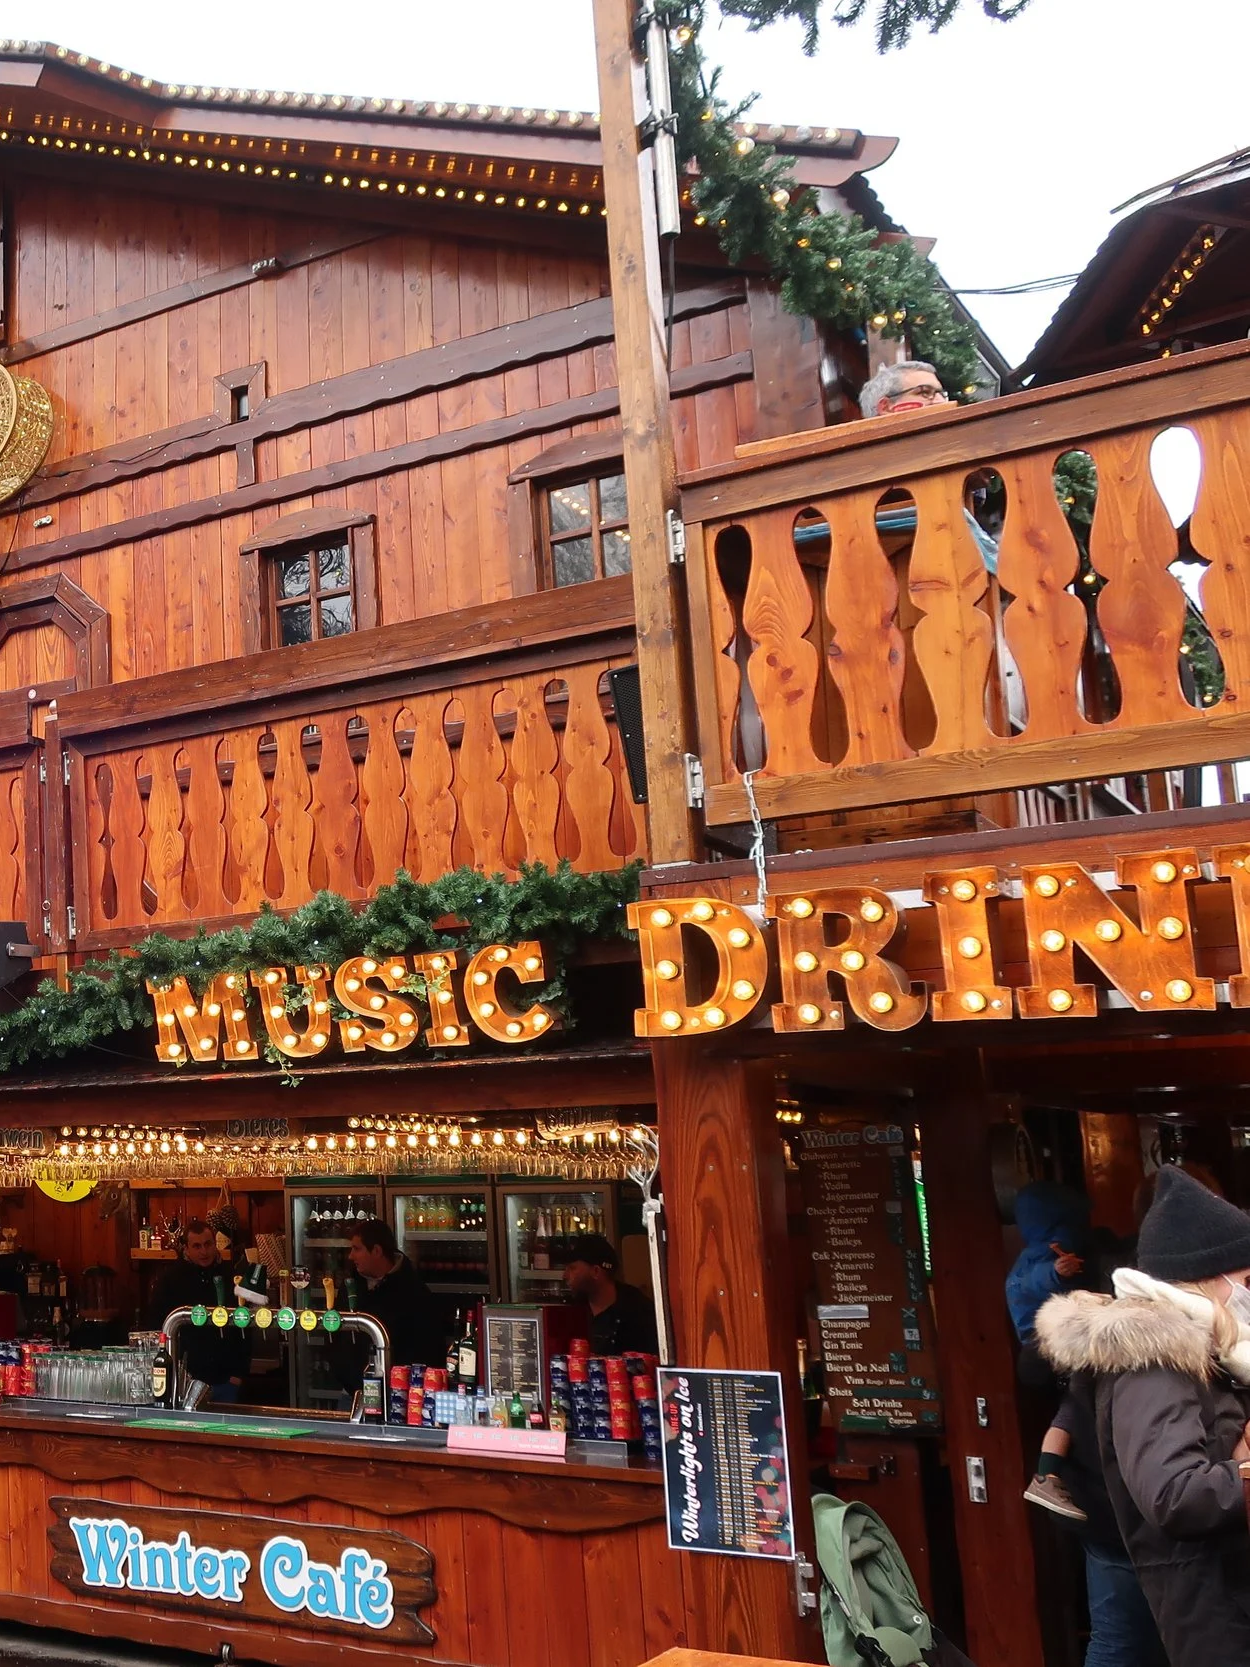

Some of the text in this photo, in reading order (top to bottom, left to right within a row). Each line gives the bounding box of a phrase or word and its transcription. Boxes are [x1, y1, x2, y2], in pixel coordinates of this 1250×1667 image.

[146, 941, 554, 1063] MUSIC
[800, 1125, 904, 1148] Winter Café
[830, 1227, 855, 1236] Rhum
[832, 1251, 875, 1261] Nespresso
[834, 1262, 874, 1271] Amaretto
[835, 1272, 861, 1281] Rhum
[836, 1283, 868, 1292] Baileys
[821, 1320, 870, 1330] Champagne
[823, 1340, 863, 1350] Gin Tonic
[855, 1363, 867, 1372] De
[844, 1375, 864, 1385] Vins
[828, 1387, 853, 1397] Shots
[852, 1398, 903, 1408] Soft Drinks
[674, 1376, 703, 1544] Winterlights on Ice
[68, 1516, 394, 1630] Winter Café
